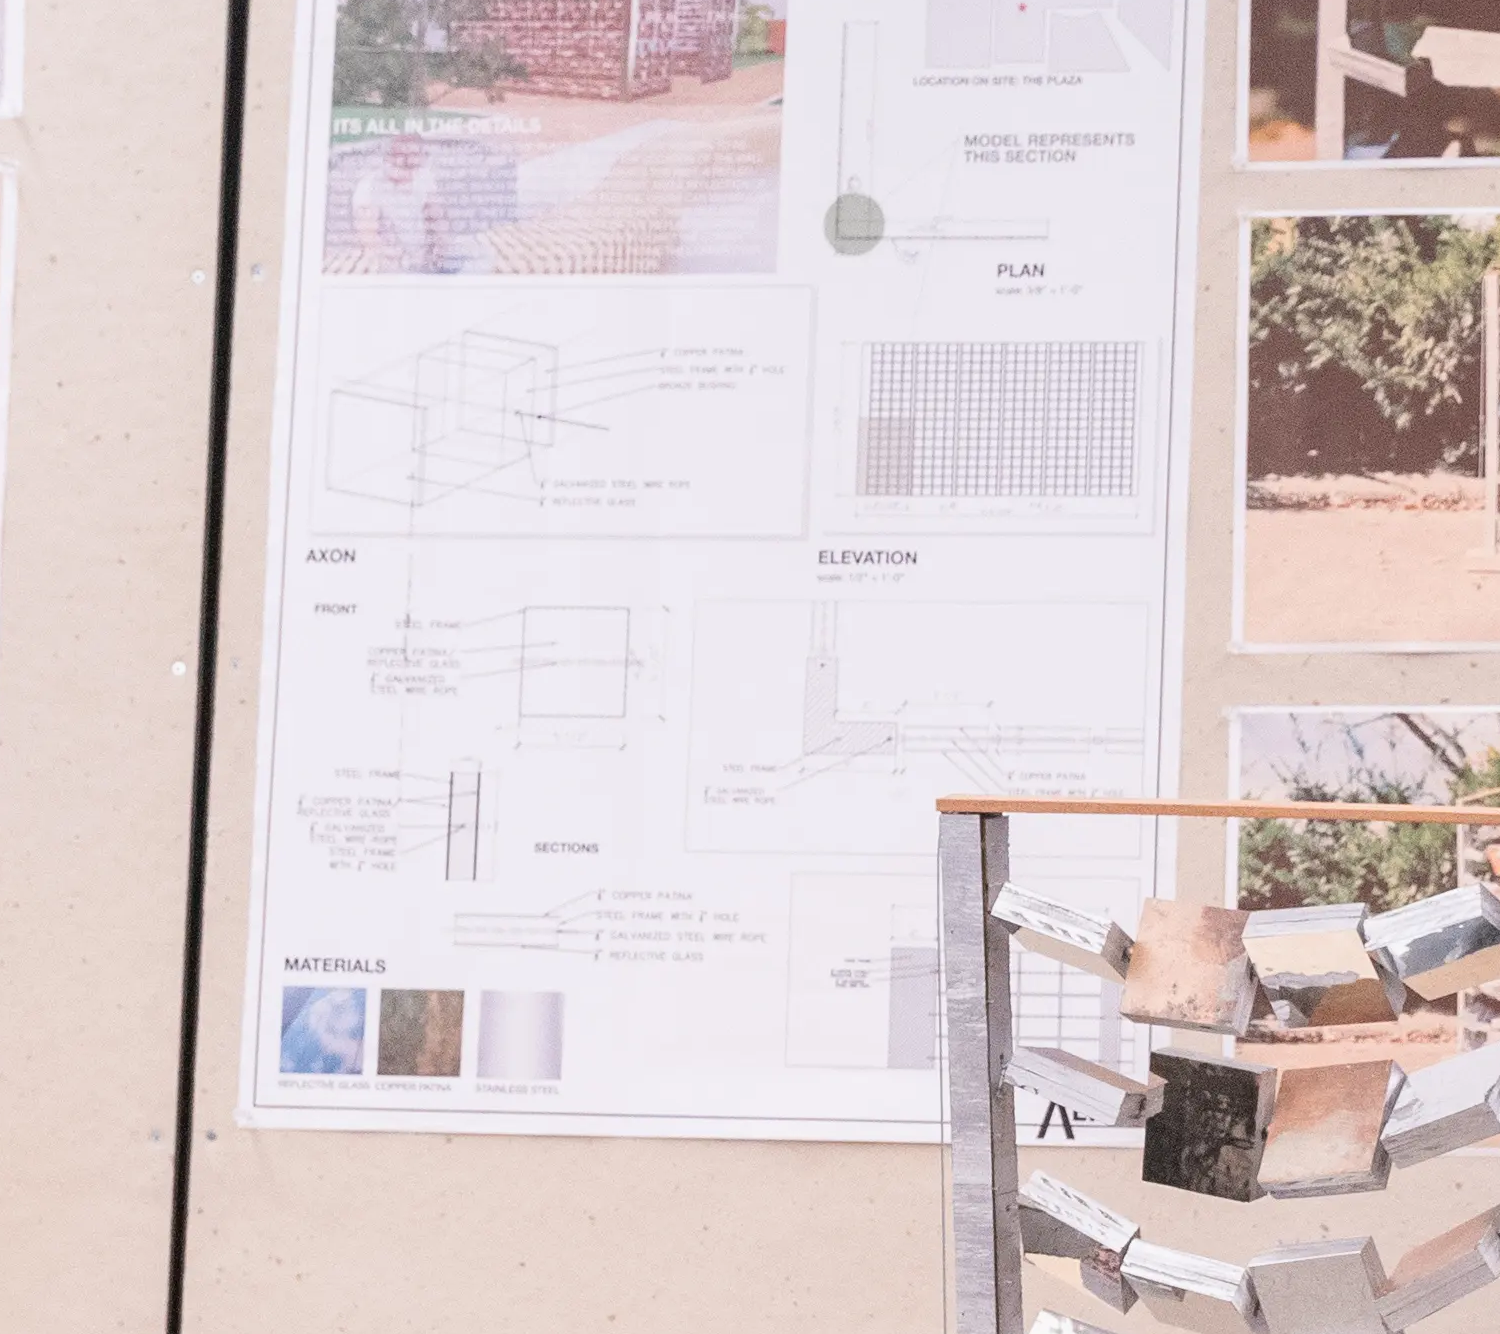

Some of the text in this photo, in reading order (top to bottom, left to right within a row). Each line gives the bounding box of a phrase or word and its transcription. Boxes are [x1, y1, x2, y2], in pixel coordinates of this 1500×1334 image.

[912, 76, 969, 87] LOCATION
[972, 76, 989, 87] ON
[1023, 76, 1043, 87] THE
[1046, 76, 1083, 87] PLAZA
[334, 117, 541, 134] ITS ALL IN THE DETAILS
[964, 132, 1136, 147] MODEL REPRESENTS
[964, 149, 1076, 163] THIS SECTION
[997, 263, 1045, 278] PLAN
[305, 548, 357, 564] AXON
[817, 550, 918, 565] ELEVATION
[314, 603, 357, 615] FRONT
[534, 842, 599, 854] SECTIONS
[284, 958, 387, 974] MATERIALS
[277, 1079, 370, 1090] REFLECTIVE GLASS
[374, 1081, 452, 1092] COPPER PATINA
[475, 1083, 560, 1095] STAINLESS STEEL
